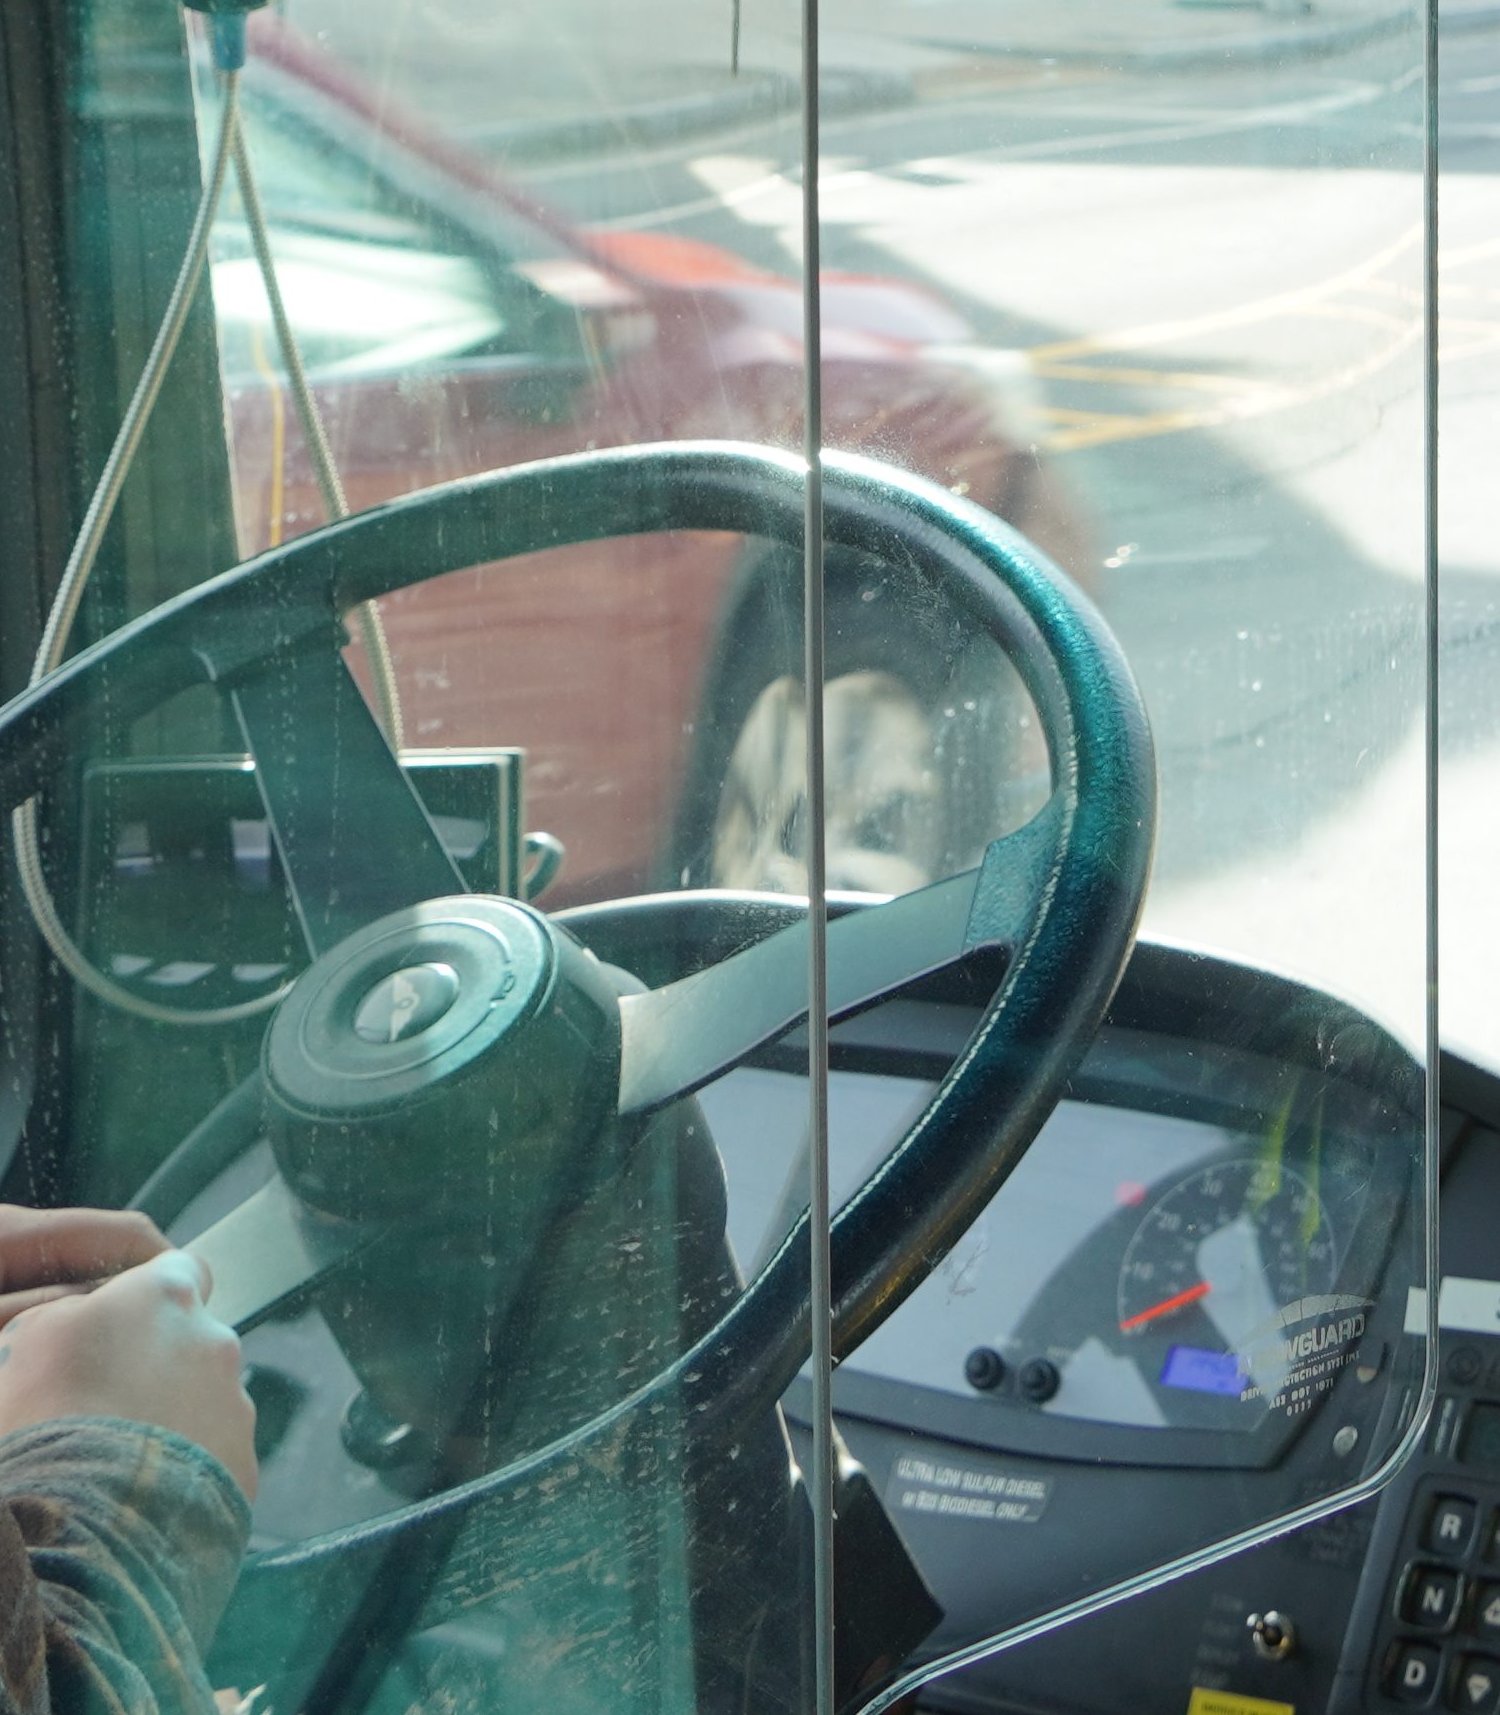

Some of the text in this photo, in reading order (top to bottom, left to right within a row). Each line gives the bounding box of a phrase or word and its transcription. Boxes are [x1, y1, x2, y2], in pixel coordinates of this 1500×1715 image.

[1440, 1512, 1463, 1540] R
[1423, 1585, 1446, 1613] N
[1404, 1659, 1427, 1687] D
